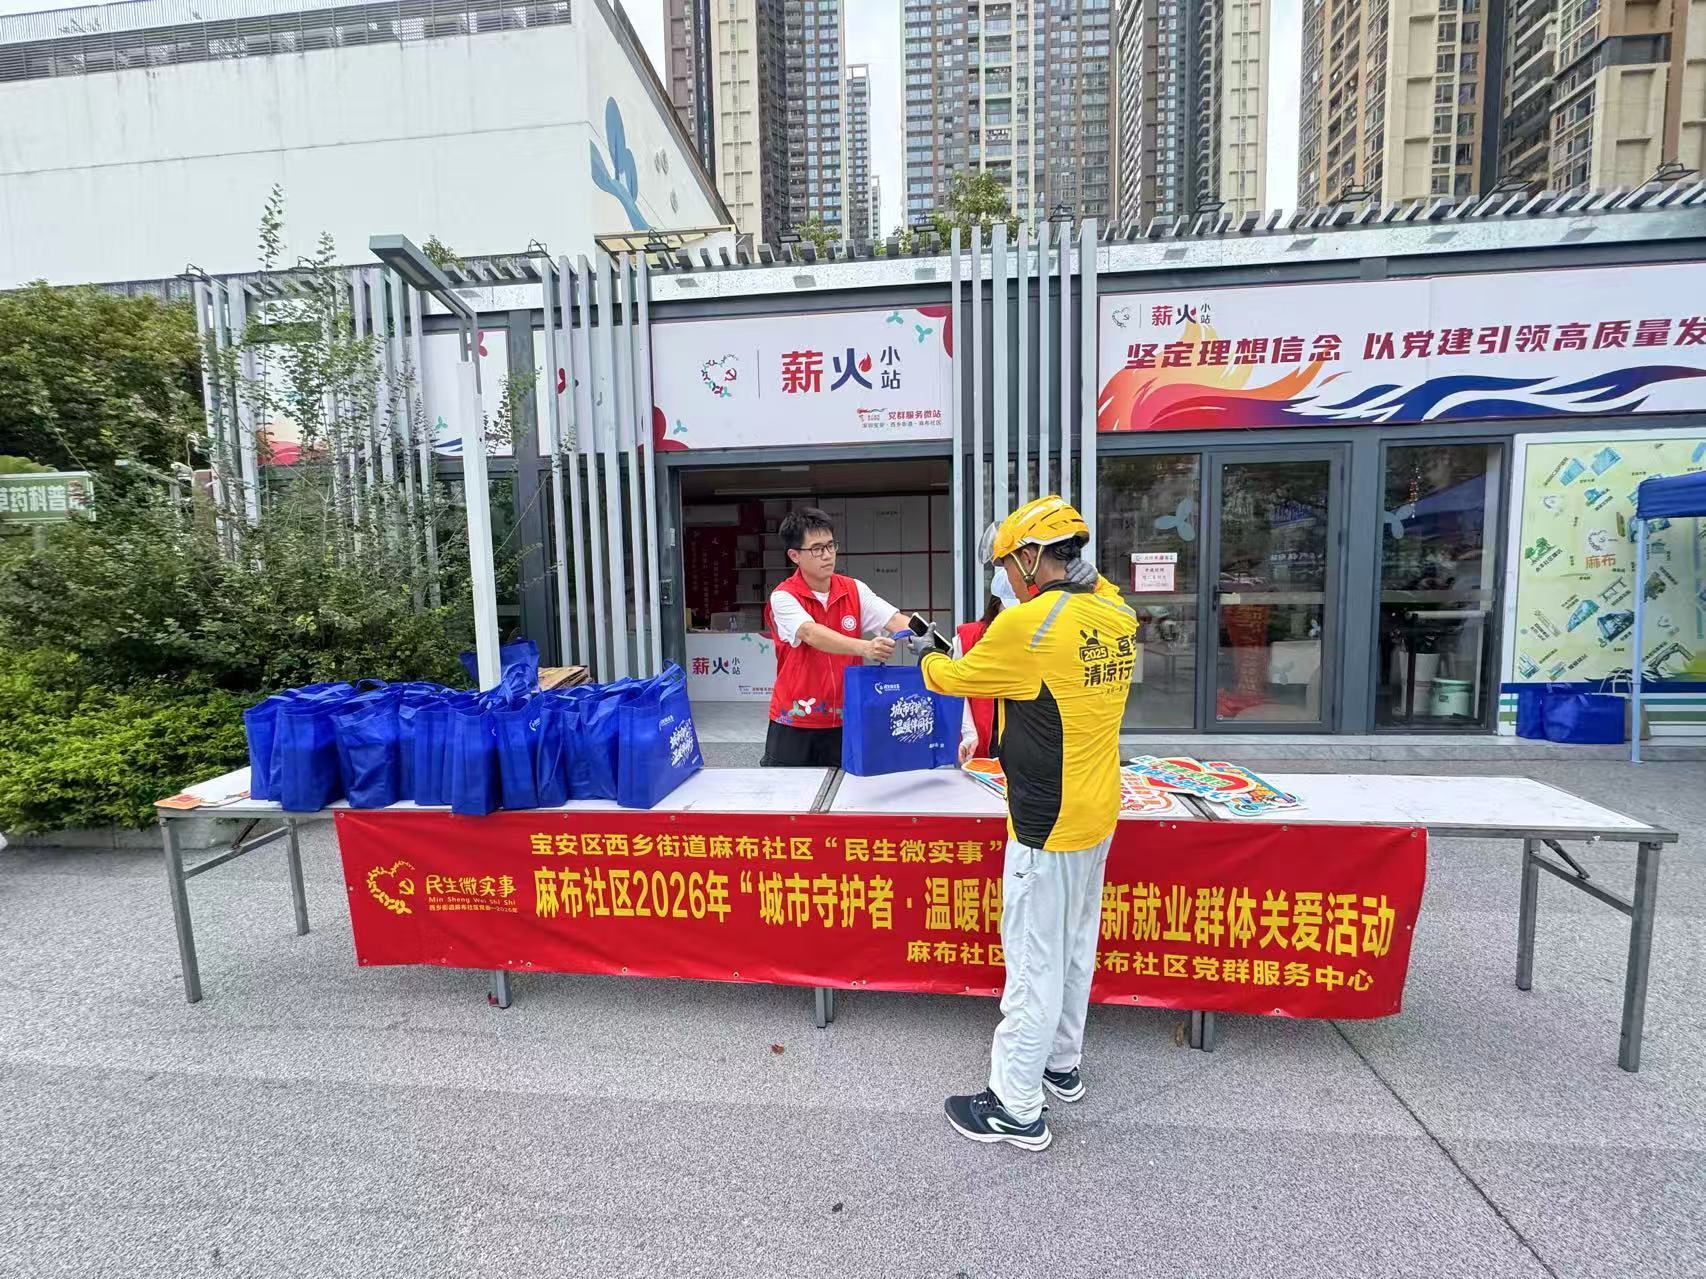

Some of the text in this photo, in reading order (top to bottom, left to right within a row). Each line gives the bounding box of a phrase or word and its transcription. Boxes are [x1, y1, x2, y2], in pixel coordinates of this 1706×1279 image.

[1152, 303, 1211, 326] 薪火 小站
[1125, 316, 1706, 369] 坚定理想信念 以党建引领高质量发
[781, 346, 901, 394] 薪火 小站
[1585, 554, 1616, 569] 麻布
[692, 656, 730, 675] 薪火
[1083, 647, 1108, 661] 2025
[1084, 660, 1136, 688] 清凉行
[425, 874, 517, 898] 民生微实事
[447, 896, 470, 904] Sheng
[1100, 881, 1396, 959] 新就业群体关爱活动
[906, 940, 1374, 992] 麻布社区 布社区党群服务中心
